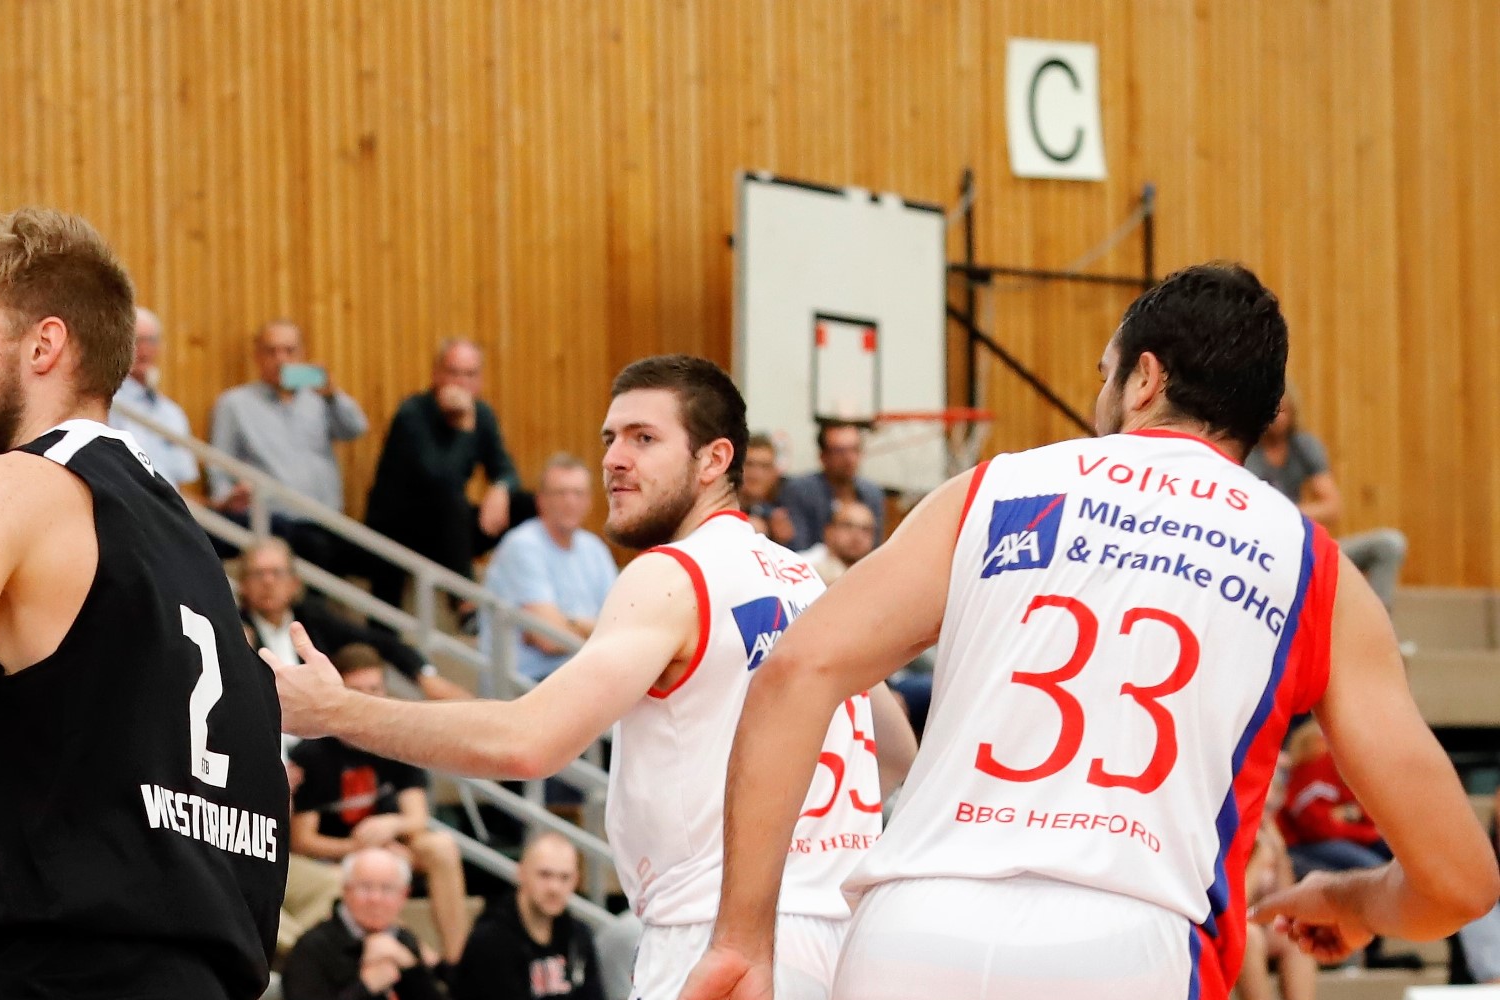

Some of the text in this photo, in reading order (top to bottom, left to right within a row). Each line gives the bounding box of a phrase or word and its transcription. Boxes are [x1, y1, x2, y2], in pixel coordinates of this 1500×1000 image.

[1025, 56, 1085, 165] C
[983, 529, 1041, 569] AXA
[1078, 496, 1276, 573] Mladenovic
[1066, 535, 1285, 637] & Franke OHG
[180, 603, 230, 789] 2
[973, 594, 1200, 795] 33
[955, 802, 1161, 854] BBG HERFORD
